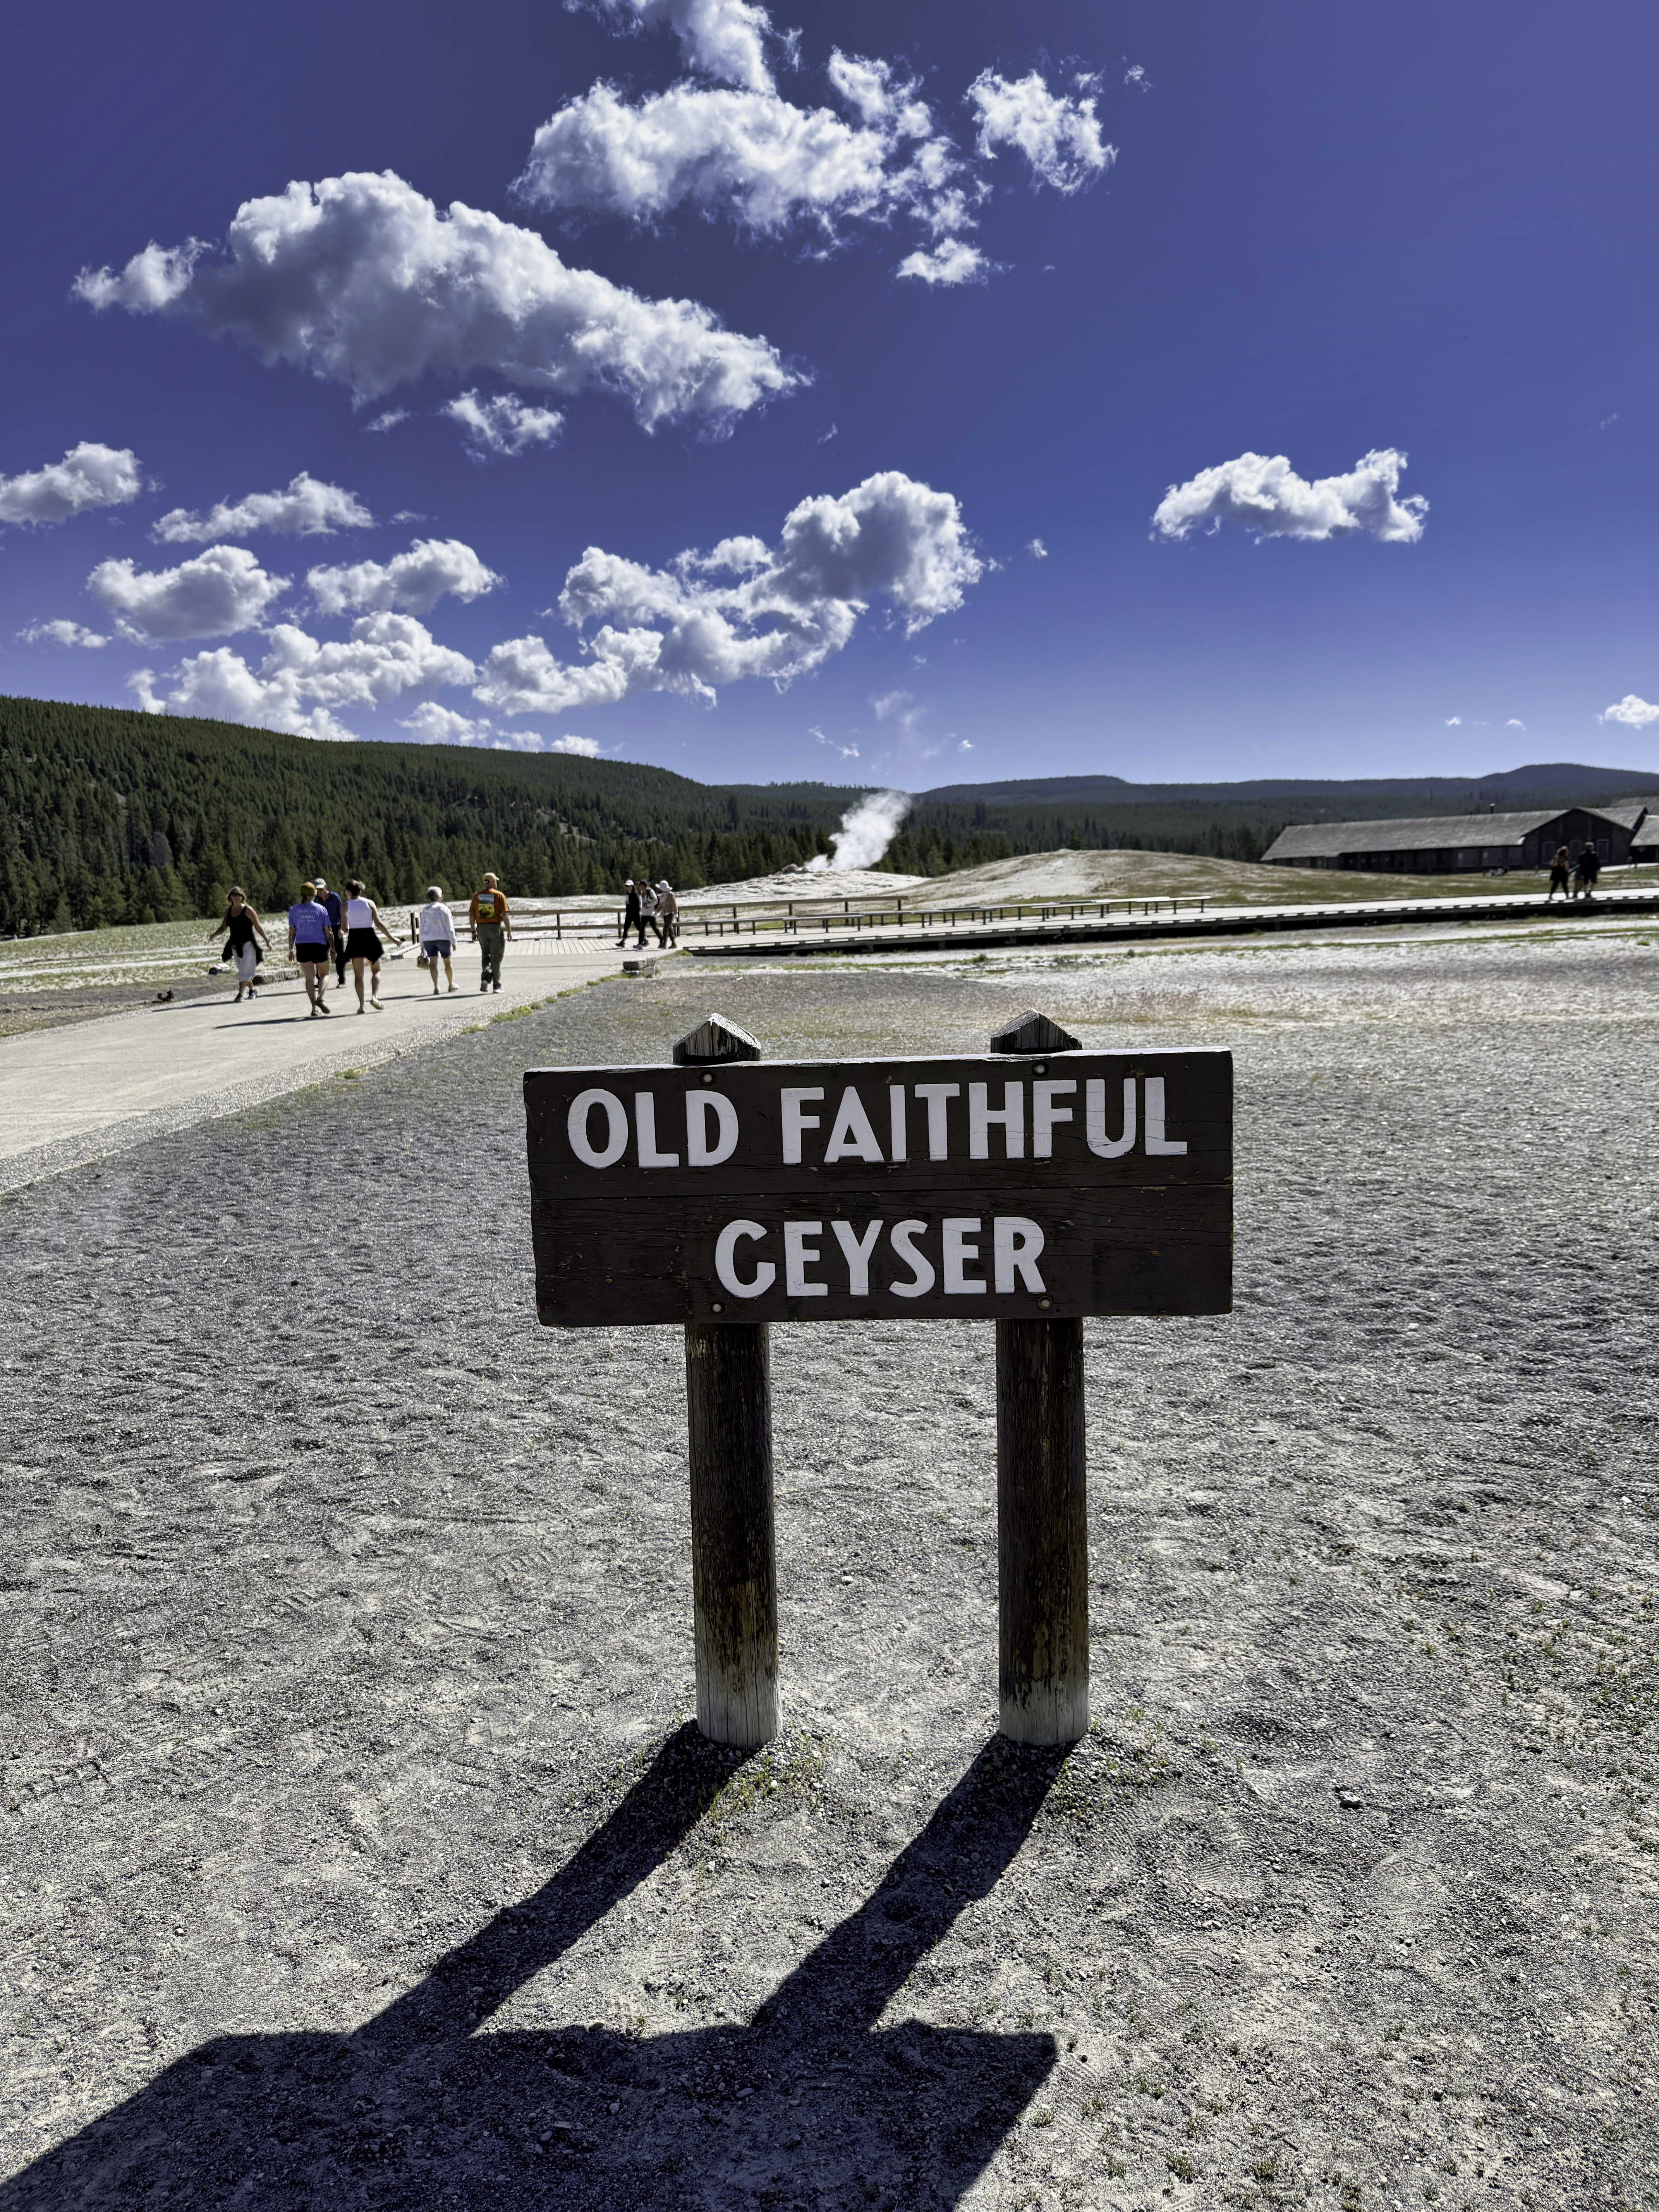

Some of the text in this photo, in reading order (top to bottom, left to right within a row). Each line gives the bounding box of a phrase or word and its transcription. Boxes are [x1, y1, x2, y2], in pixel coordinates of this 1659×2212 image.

[567, 1077, 1188, 1168] OLD FAITHFUL
[715, 1217, 1047, 1298] GEYSER
